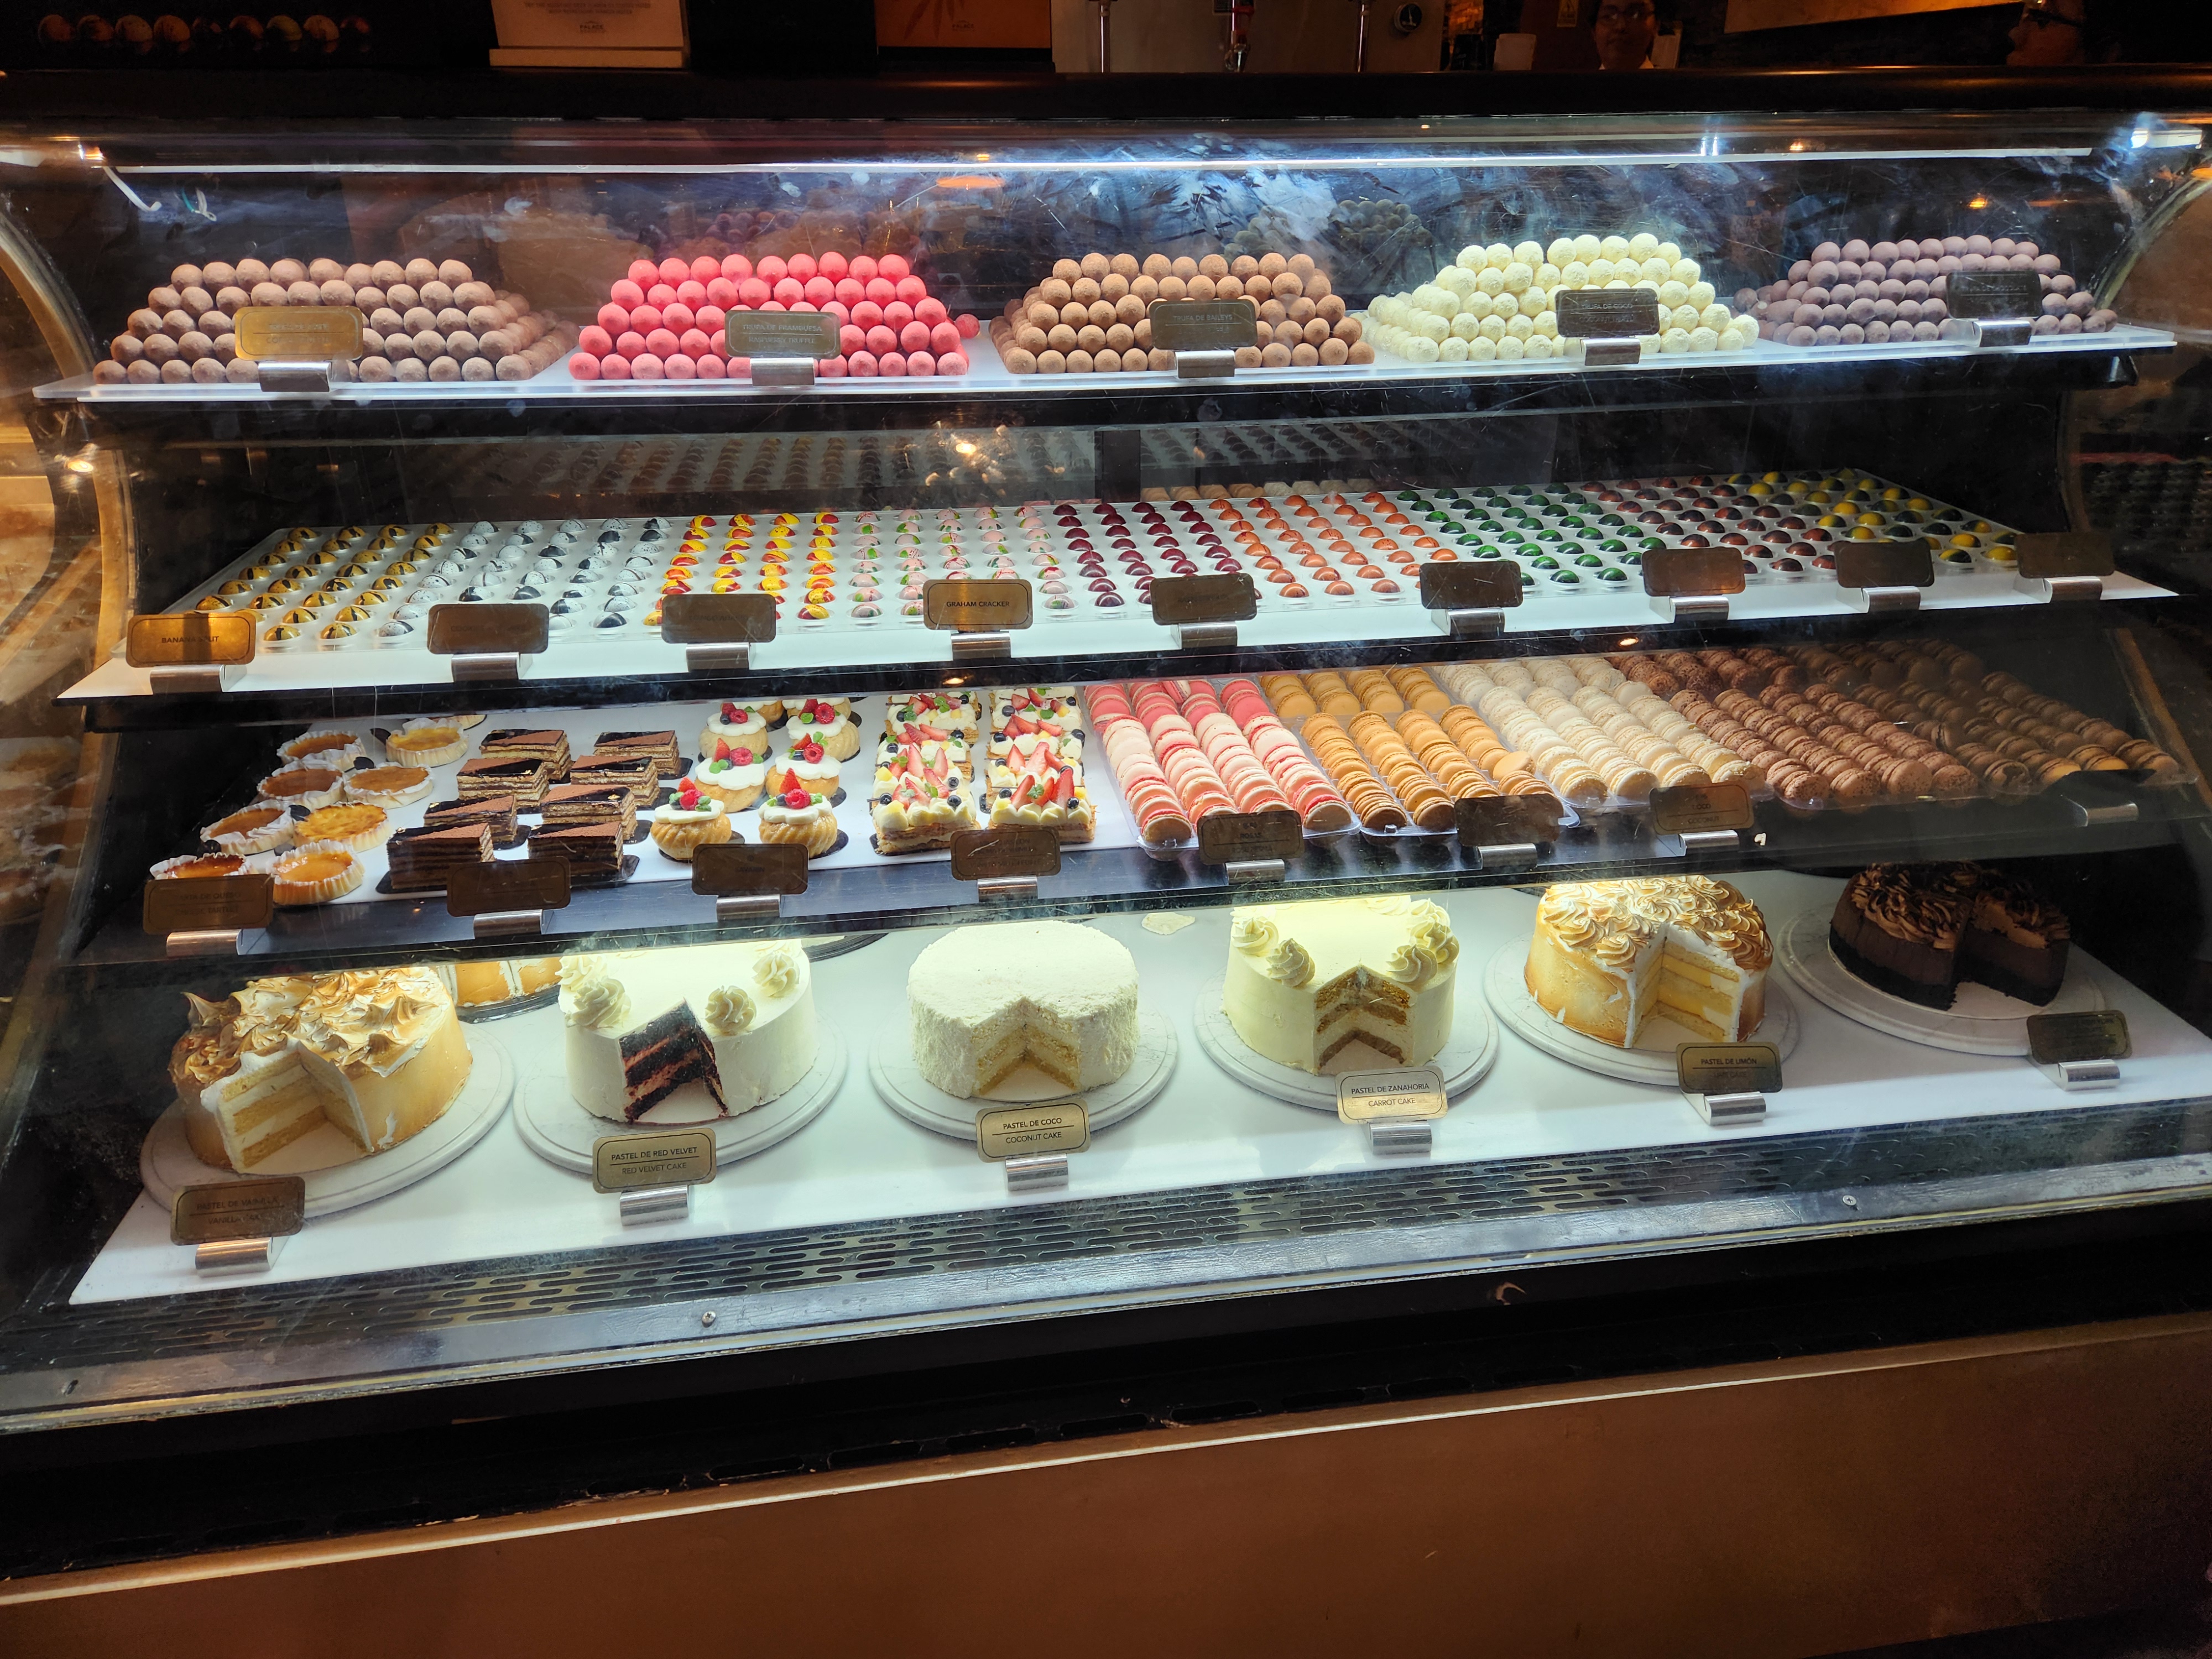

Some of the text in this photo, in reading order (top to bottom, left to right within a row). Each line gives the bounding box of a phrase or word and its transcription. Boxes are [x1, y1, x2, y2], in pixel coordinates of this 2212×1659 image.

[1688, 816, 1719, 824] COCONUT
[1388, 1083, 1430, 1092] ZANAHORIA
[1006, 1134, 1042, 1144] COCONUT
[612, 1152, 638, 1161] PASTEL
[670, 1147, 697, 1155] VELVET
[639, 1165, 665, 1173] VELVET
[197, 1202, 226, 1210] PASTEL
